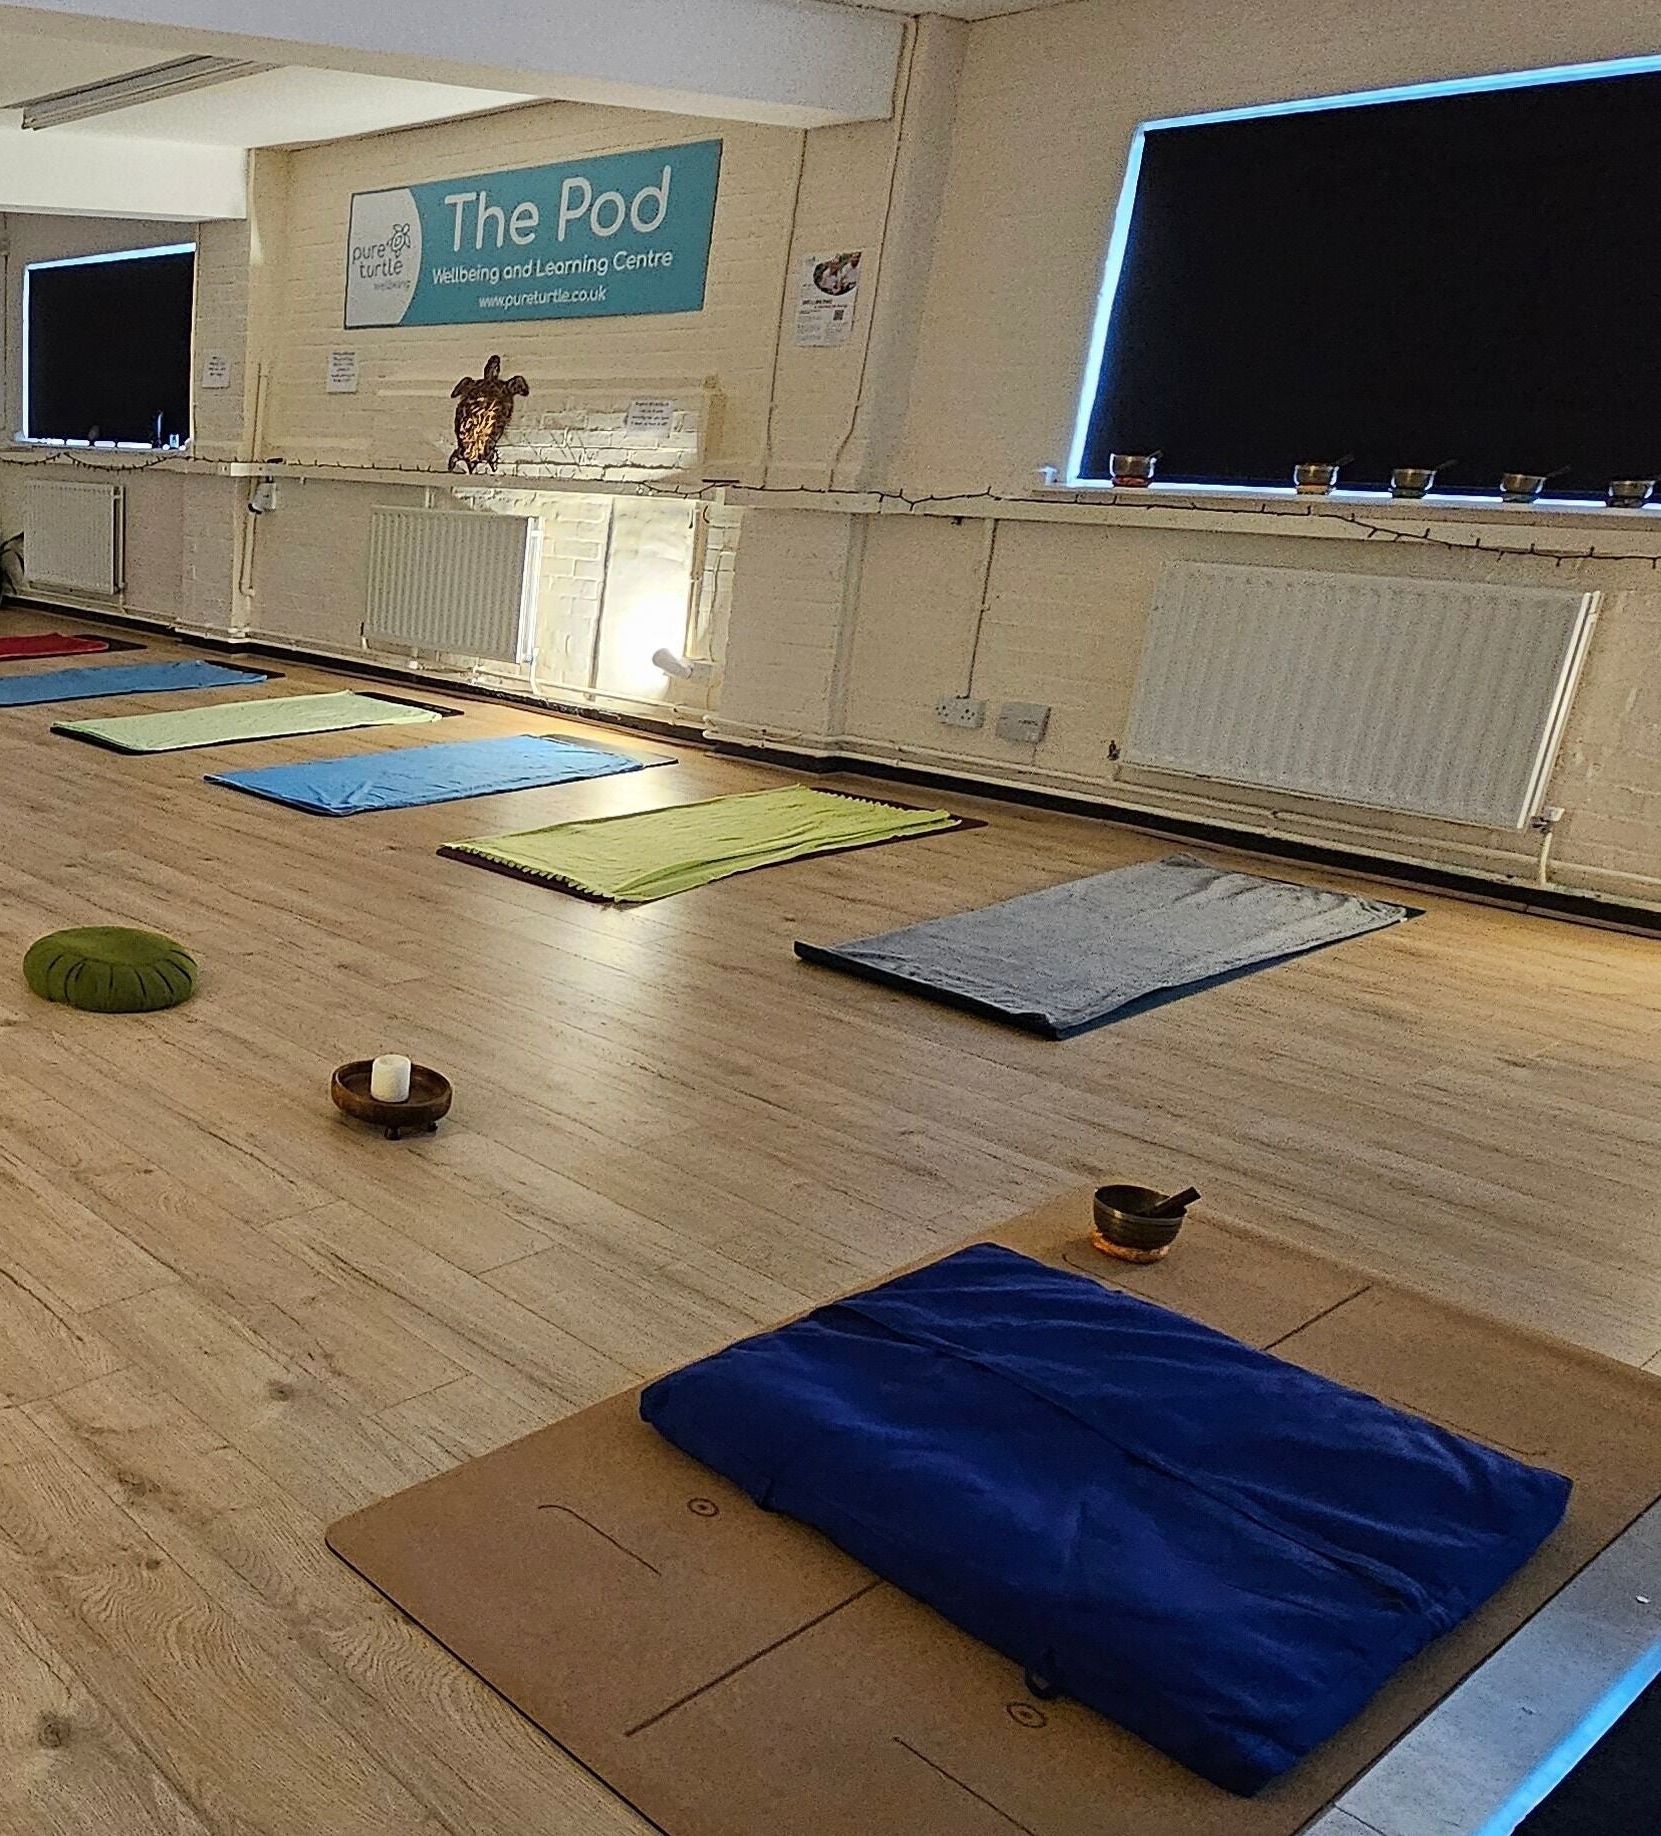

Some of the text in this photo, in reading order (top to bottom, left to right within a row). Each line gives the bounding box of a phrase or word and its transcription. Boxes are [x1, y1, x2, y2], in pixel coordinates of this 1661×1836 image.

[444, 164, 672, 252] The Pod
[352, 243, 386, 264] pure
[359, 258, 403, 279] turtle
[432, 249, 674, 285] Wellbeing and Learning Centre
[478, 285, 607, 310] www.pureturtle.co.uk
